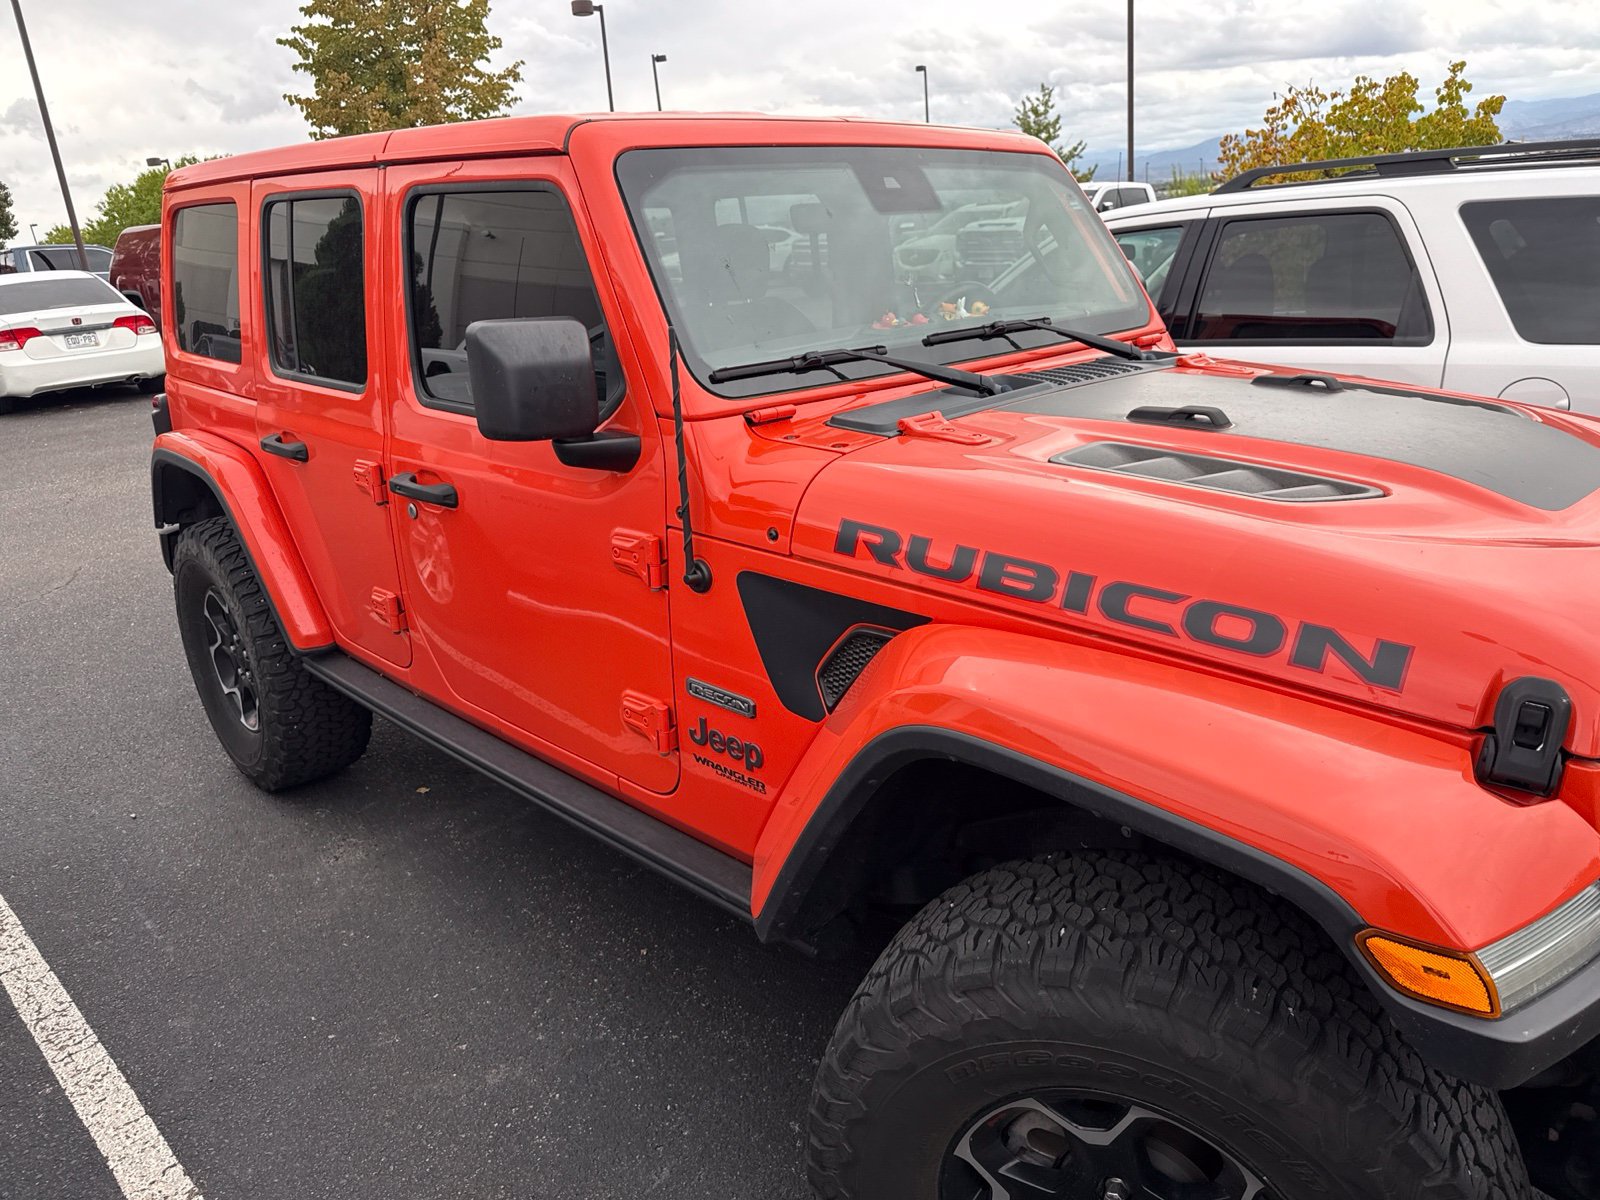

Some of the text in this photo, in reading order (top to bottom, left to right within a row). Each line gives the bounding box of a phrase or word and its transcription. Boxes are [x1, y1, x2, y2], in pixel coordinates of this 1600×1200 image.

[834, 517, 1415, 693] RUBICON
[690, 683, 748, 712] RECON
[689, 716, 764, 771] Jeep
[692, 753, 766, 790] WRANGLER
[715, 770, 767, 794] UNLIMITED
